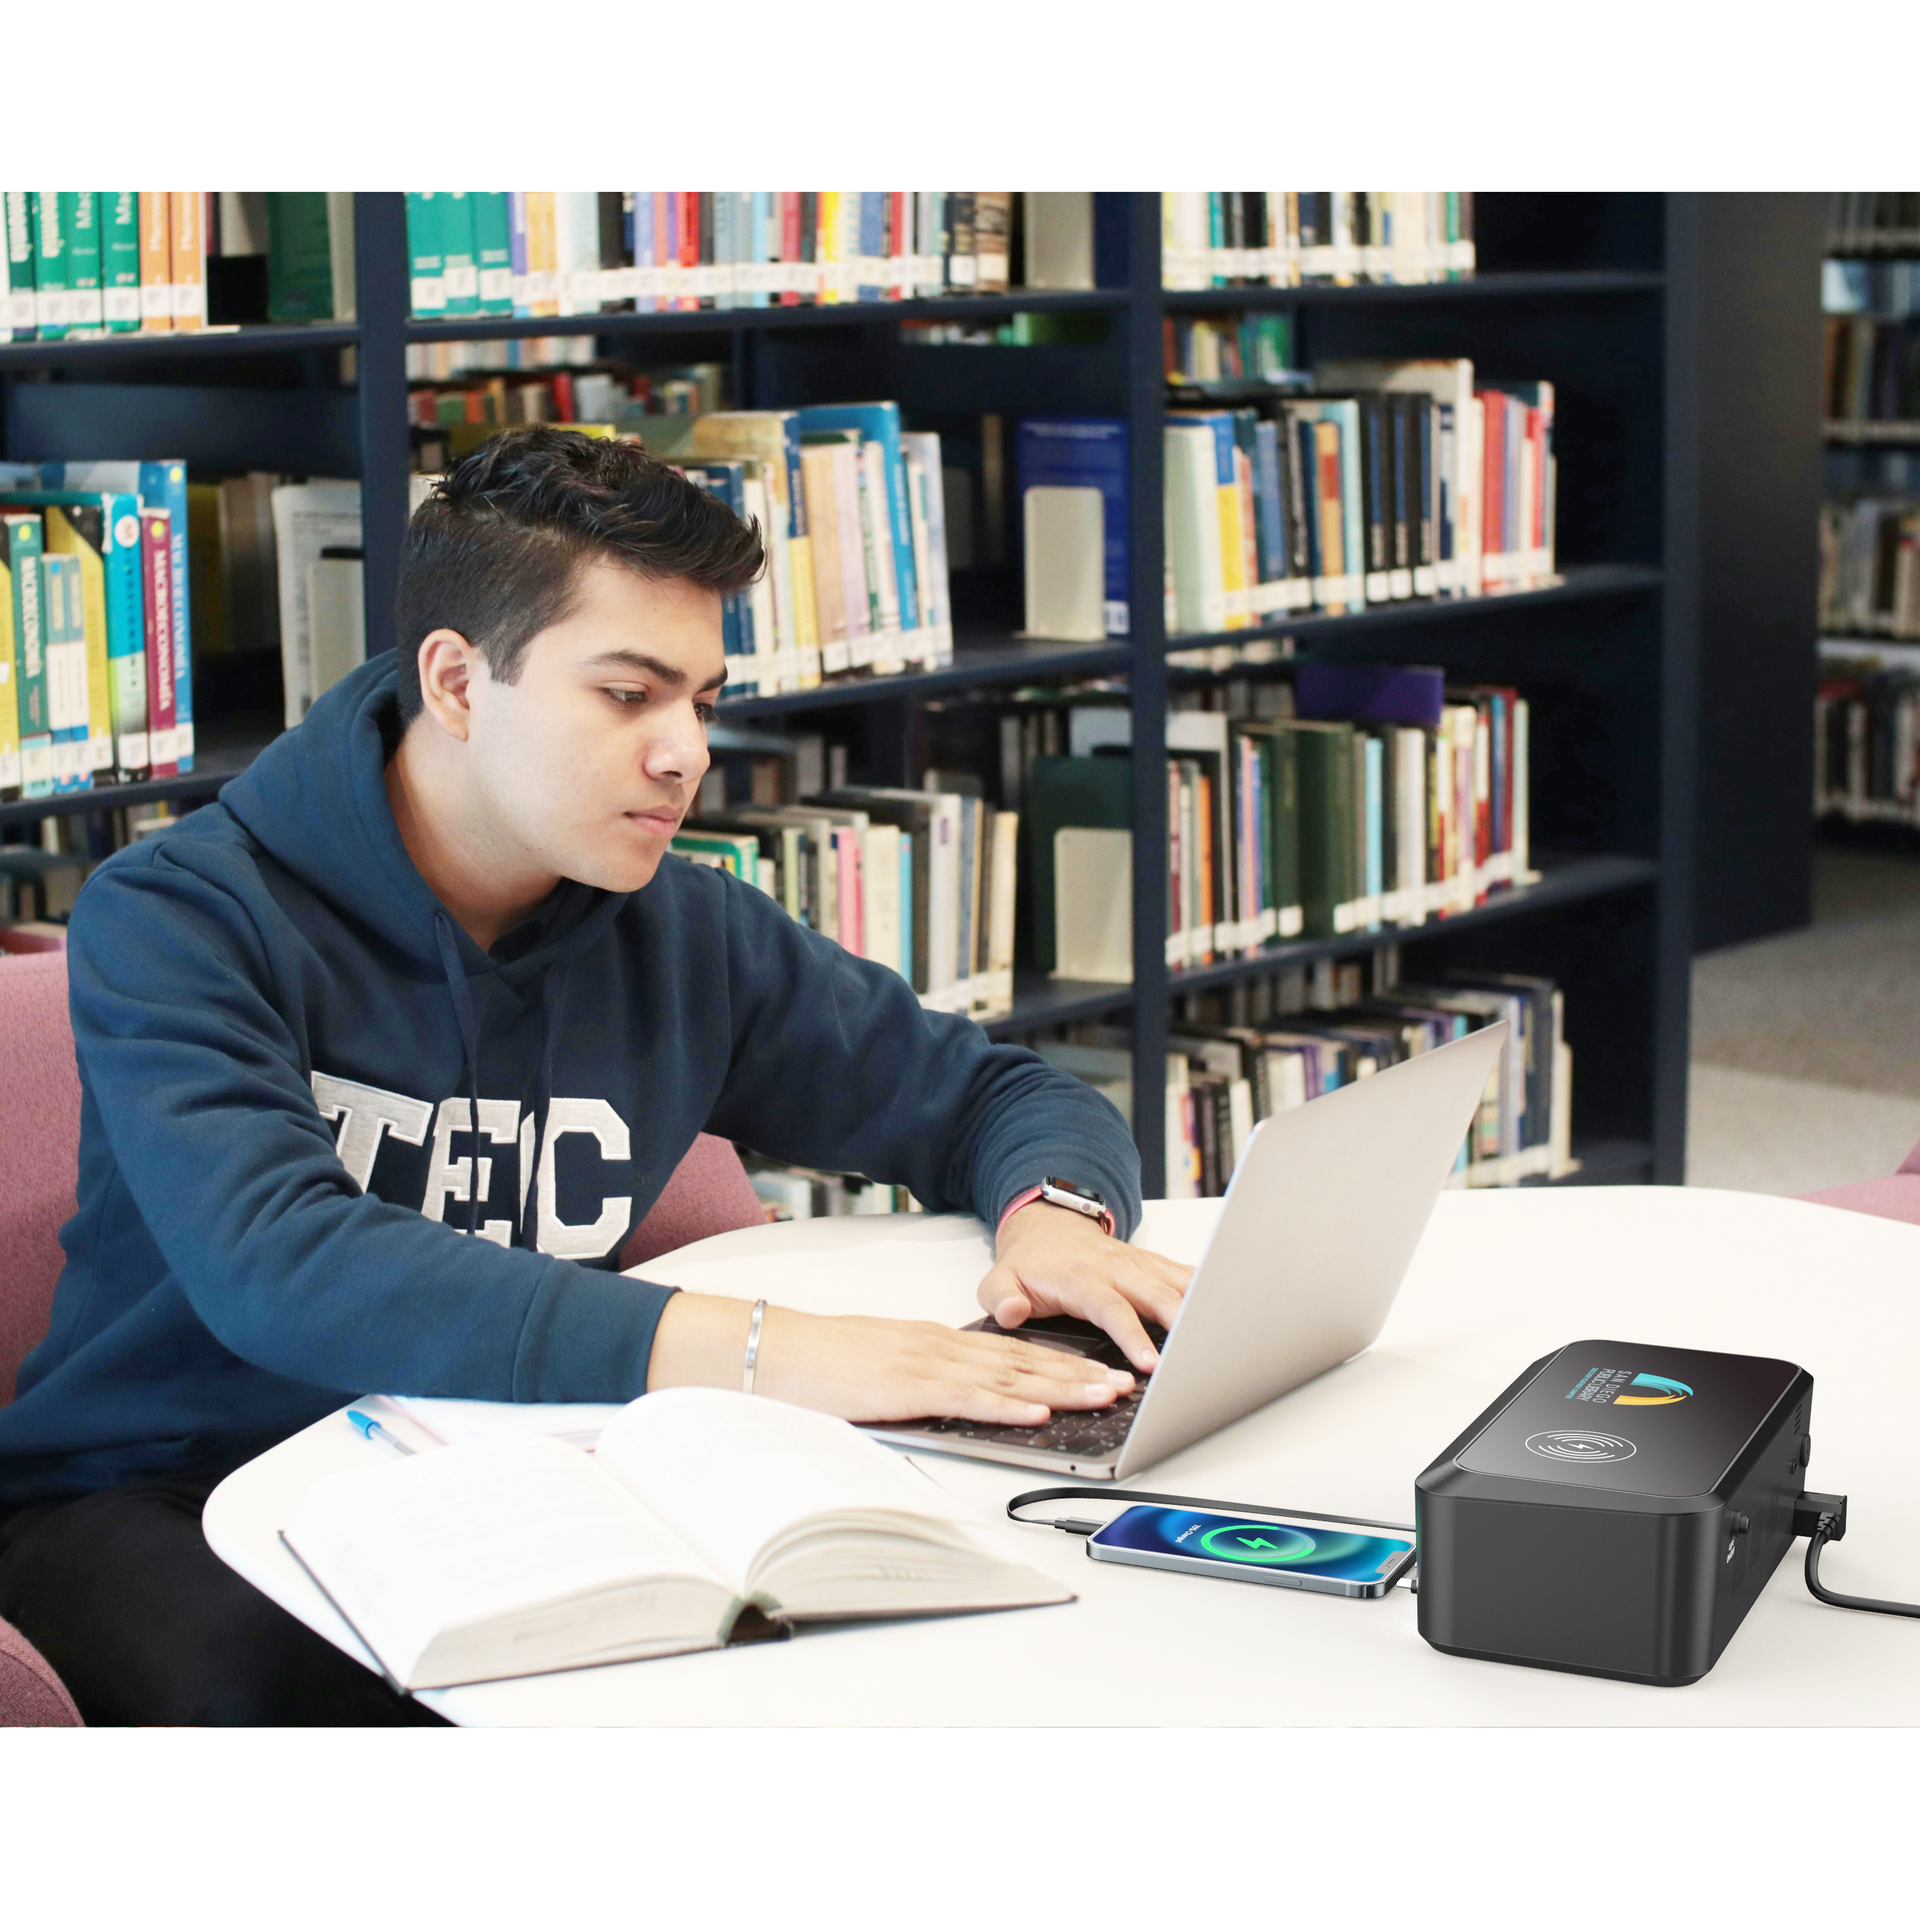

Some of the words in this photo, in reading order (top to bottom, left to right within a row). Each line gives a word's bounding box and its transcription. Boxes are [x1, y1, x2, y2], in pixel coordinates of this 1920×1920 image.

[310, 1070, 632, 1260] TEC
[1591, 1368, 1616, 1384] PUBLIC
[1610, 1370, 1632, 1384] SAN
[1575, 1382, 1602, 1402] LIBRARY
[1592, 1383, 1620, 1404] DIEGO
